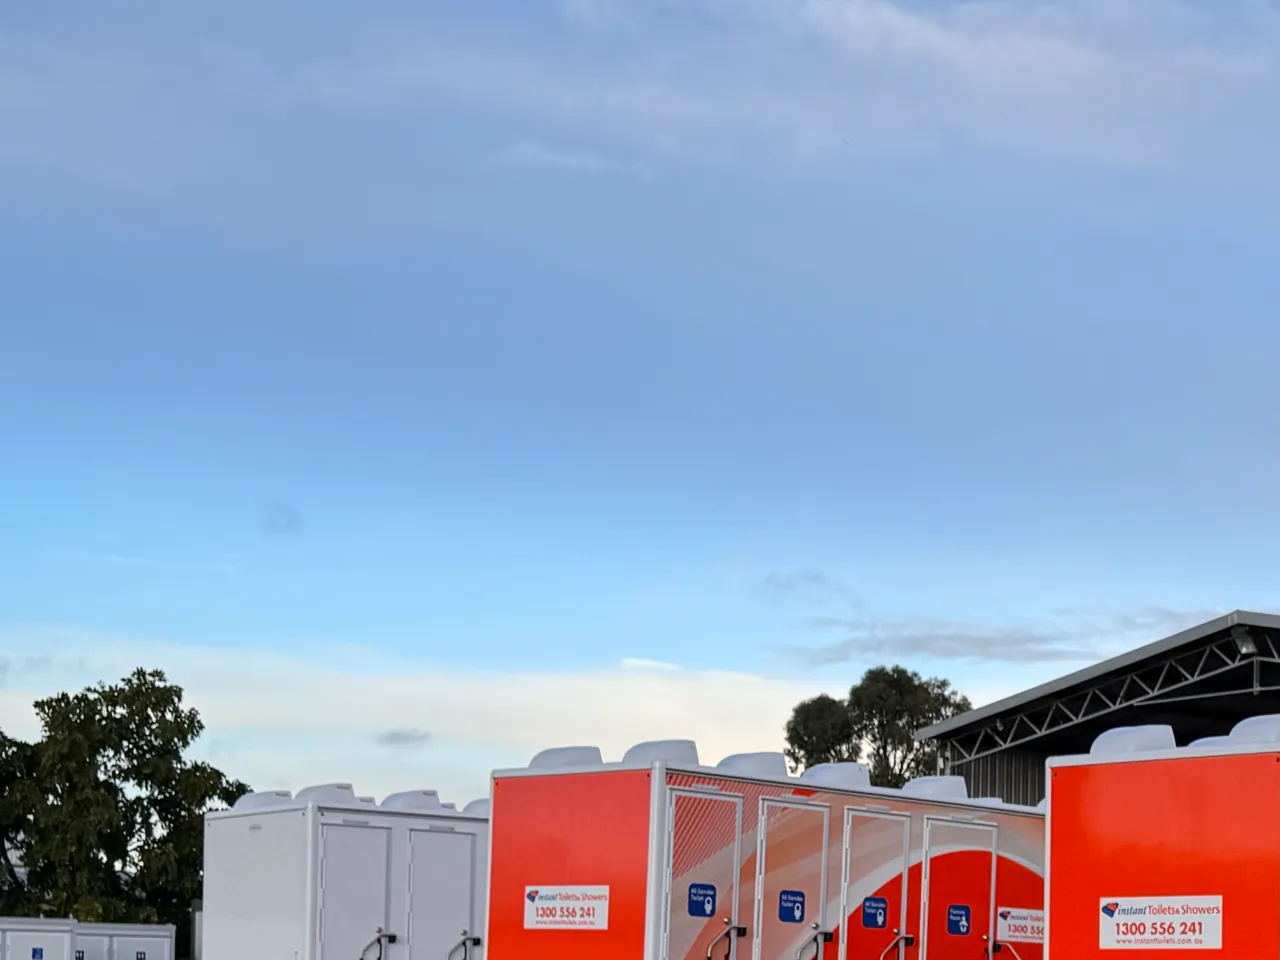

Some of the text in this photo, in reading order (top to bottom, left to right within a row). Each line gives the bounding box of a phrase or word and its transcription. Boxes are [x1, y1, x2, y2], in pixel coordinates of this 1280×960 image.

[536, 906, 596, 918] 1300 556 241
[1117, 905, 1147, 915] instant
[1181, 904, 1220, 915] Showers
[1008, 924, 1028, 934] 1300
[1115, 922, 1203, 935] 1300 556 241
